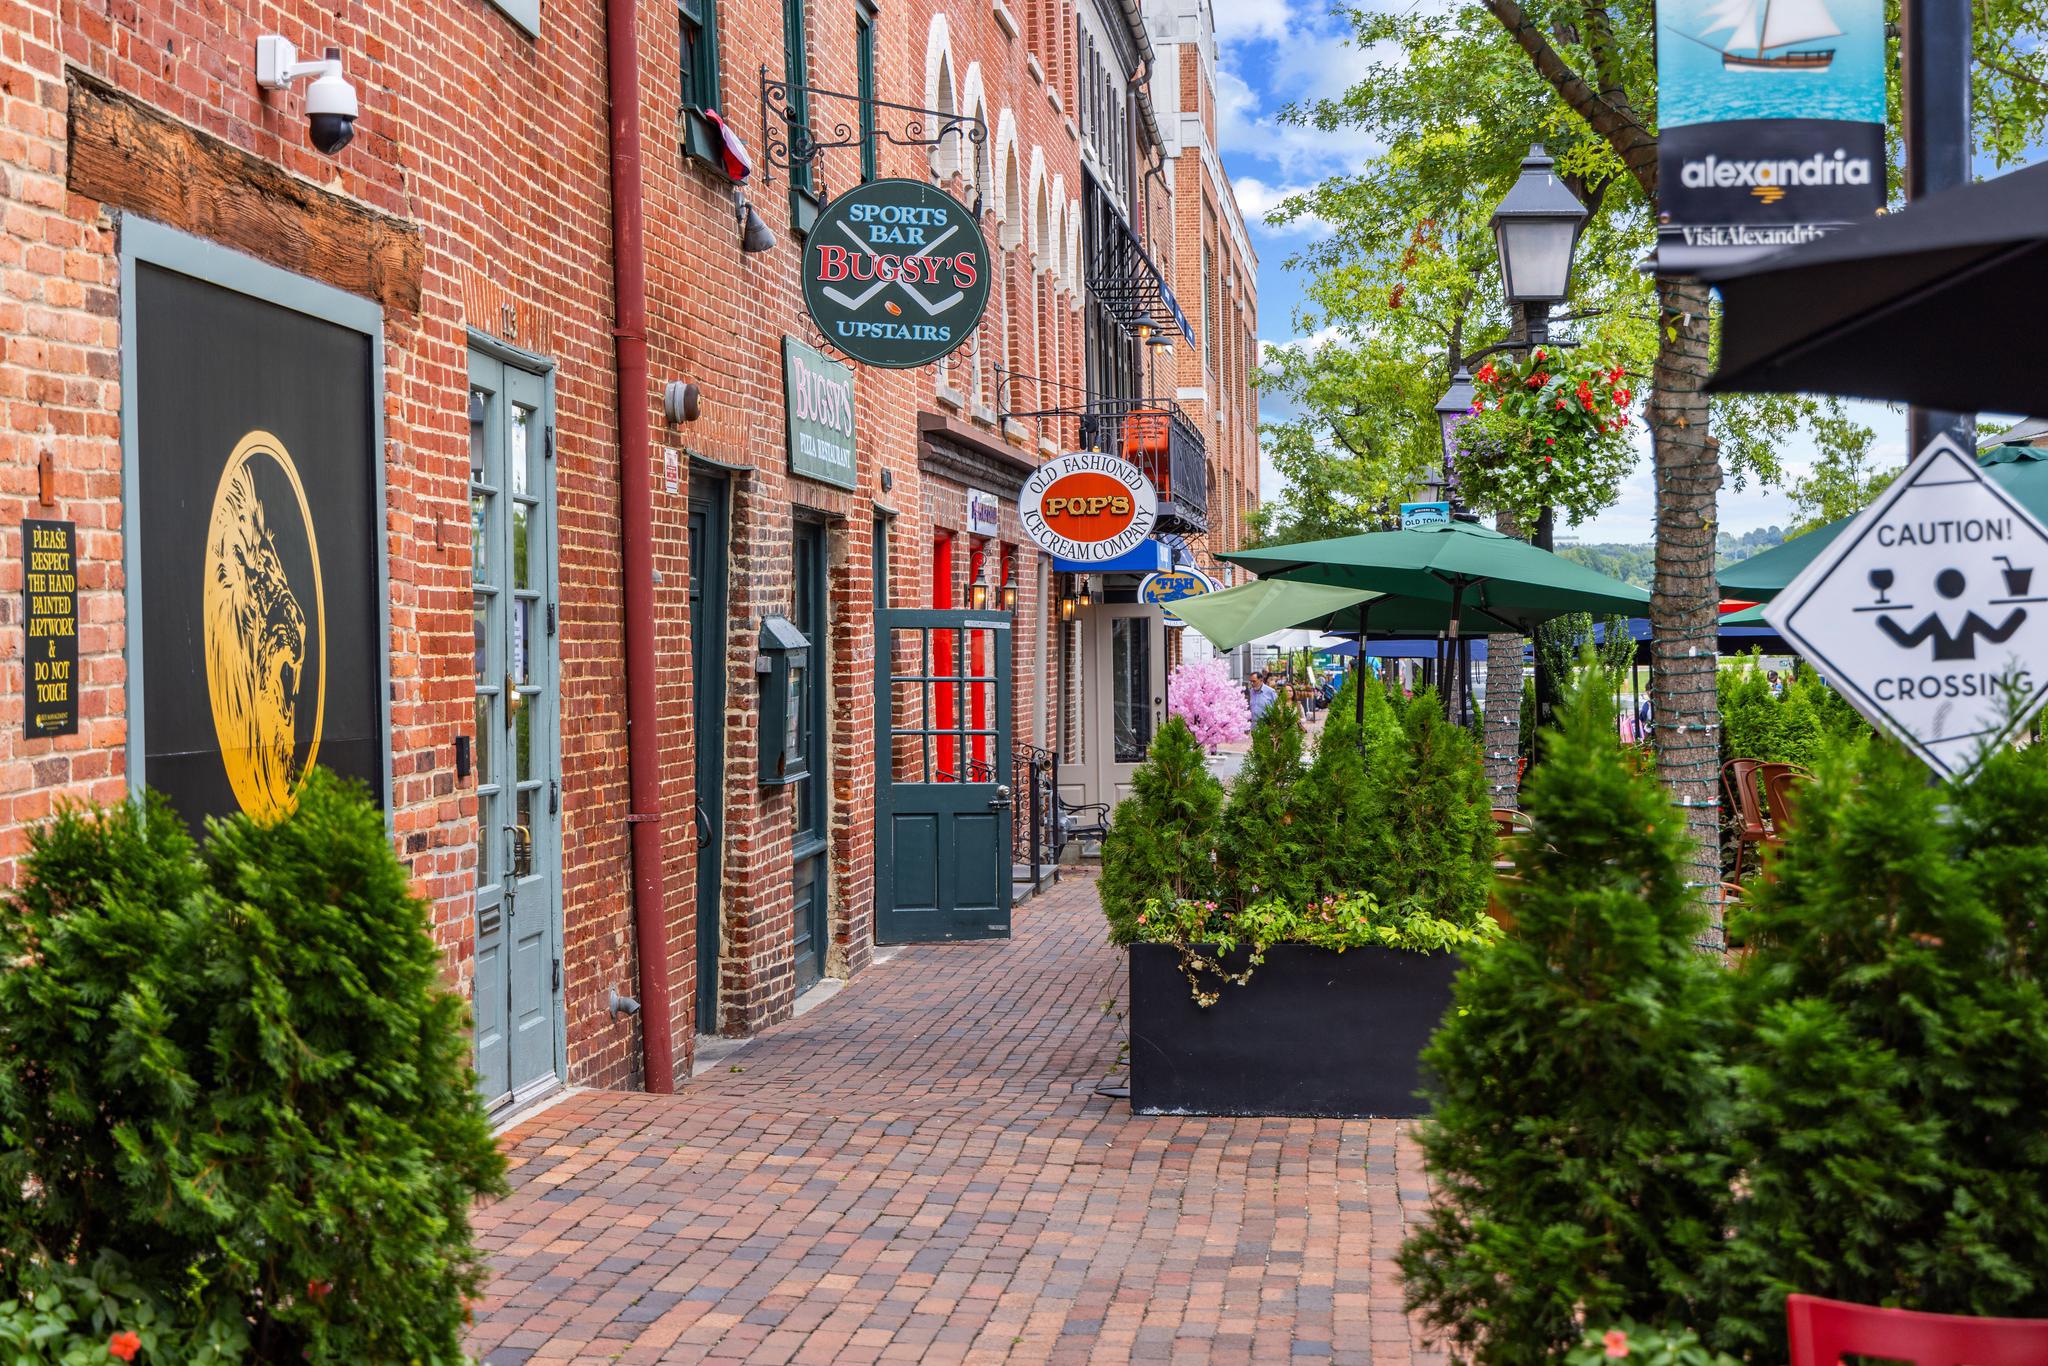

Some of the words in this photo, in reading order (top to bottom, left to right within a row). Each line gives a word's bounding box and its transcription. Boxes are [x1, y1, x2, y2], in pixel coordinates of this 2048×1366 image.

[1680, 148, 1871, 188] alexandria
[850, 203, 947, 226] SPORTS
[869, 224, 926, 245] BAR
[816, 245, 977, 288] BUGSY'S
[837, 321, 950, 342] UPSTAIRS
[793, 356, 851, 438] BUGSY'S
[800, 432, 817, 457] PIZZA
[818, 439, 850, 468] RESTAURANT
[1030, 467, 1057, 494] OLD
[1063, 455, 1143, 491] FASHIONED
[1046, 496, 1129, 516] POP'S
[33, 530, 67, 549] PLEASE
[1023, 508, 1046, 536] ICE
[1040, 530, 1089, 560] CREAM
[1093, 505, 1154, 560] COMPANY
[1877, 518, 2012, 547] CAUTION!
[31, 552, 70, 571] RESPECT
[28, 574, 46, 592] THE
[48, 574, 75, 593] HAND
[1156, 578, 1195, 589] FISH
[33, 596, 71, 614] PAINTED
[29, 618, 75, 637] ARTWORK
[48, 640, 56, 658] &
[35, 662, 49, 681] DO
[51, 661, 70, 680] NOT
[37, 683, 67, 703] TOUCH
[1874, 670, 2034, 701] CROSSING
